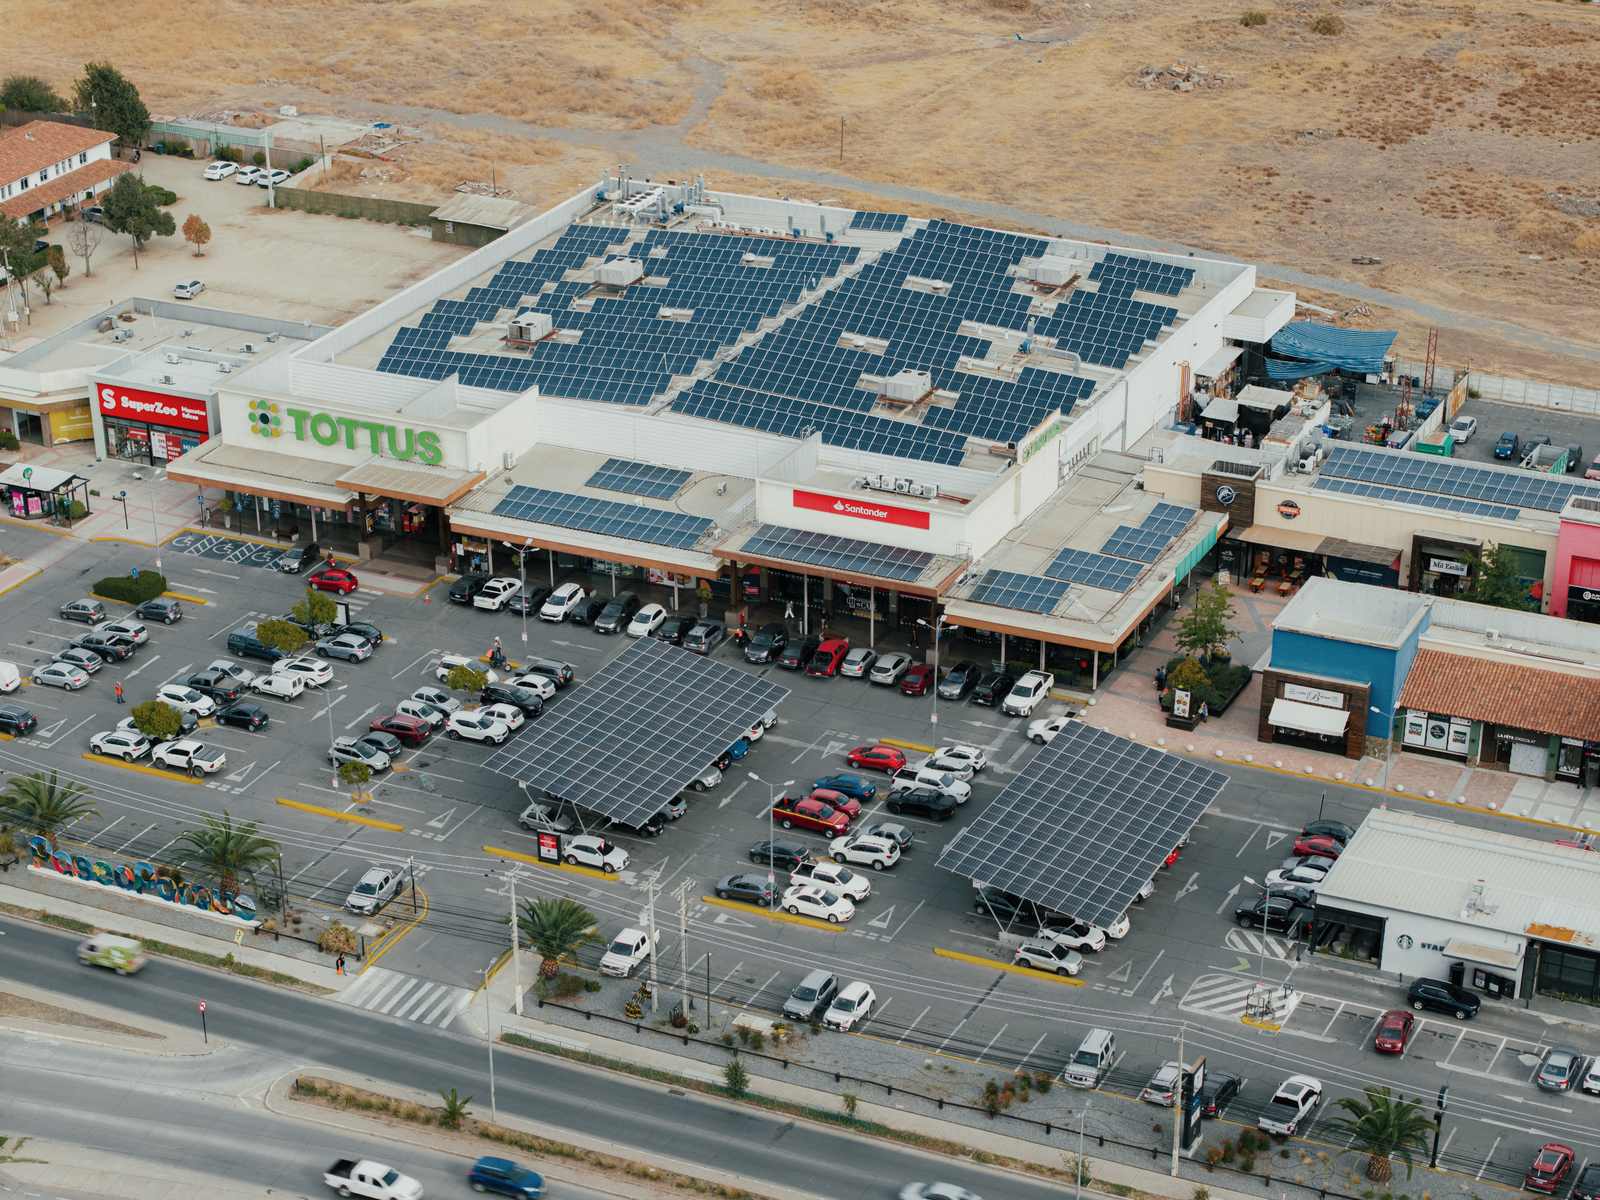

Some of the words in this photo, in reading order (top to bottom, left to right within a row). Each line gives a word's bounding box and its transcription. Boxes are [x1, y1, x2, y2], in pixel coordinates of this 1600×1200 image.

[121, 396, 178, 416] SuperZoo
[287, 408, 443, 465] TOTTUS
[844, 503, 888, 518] Santander
